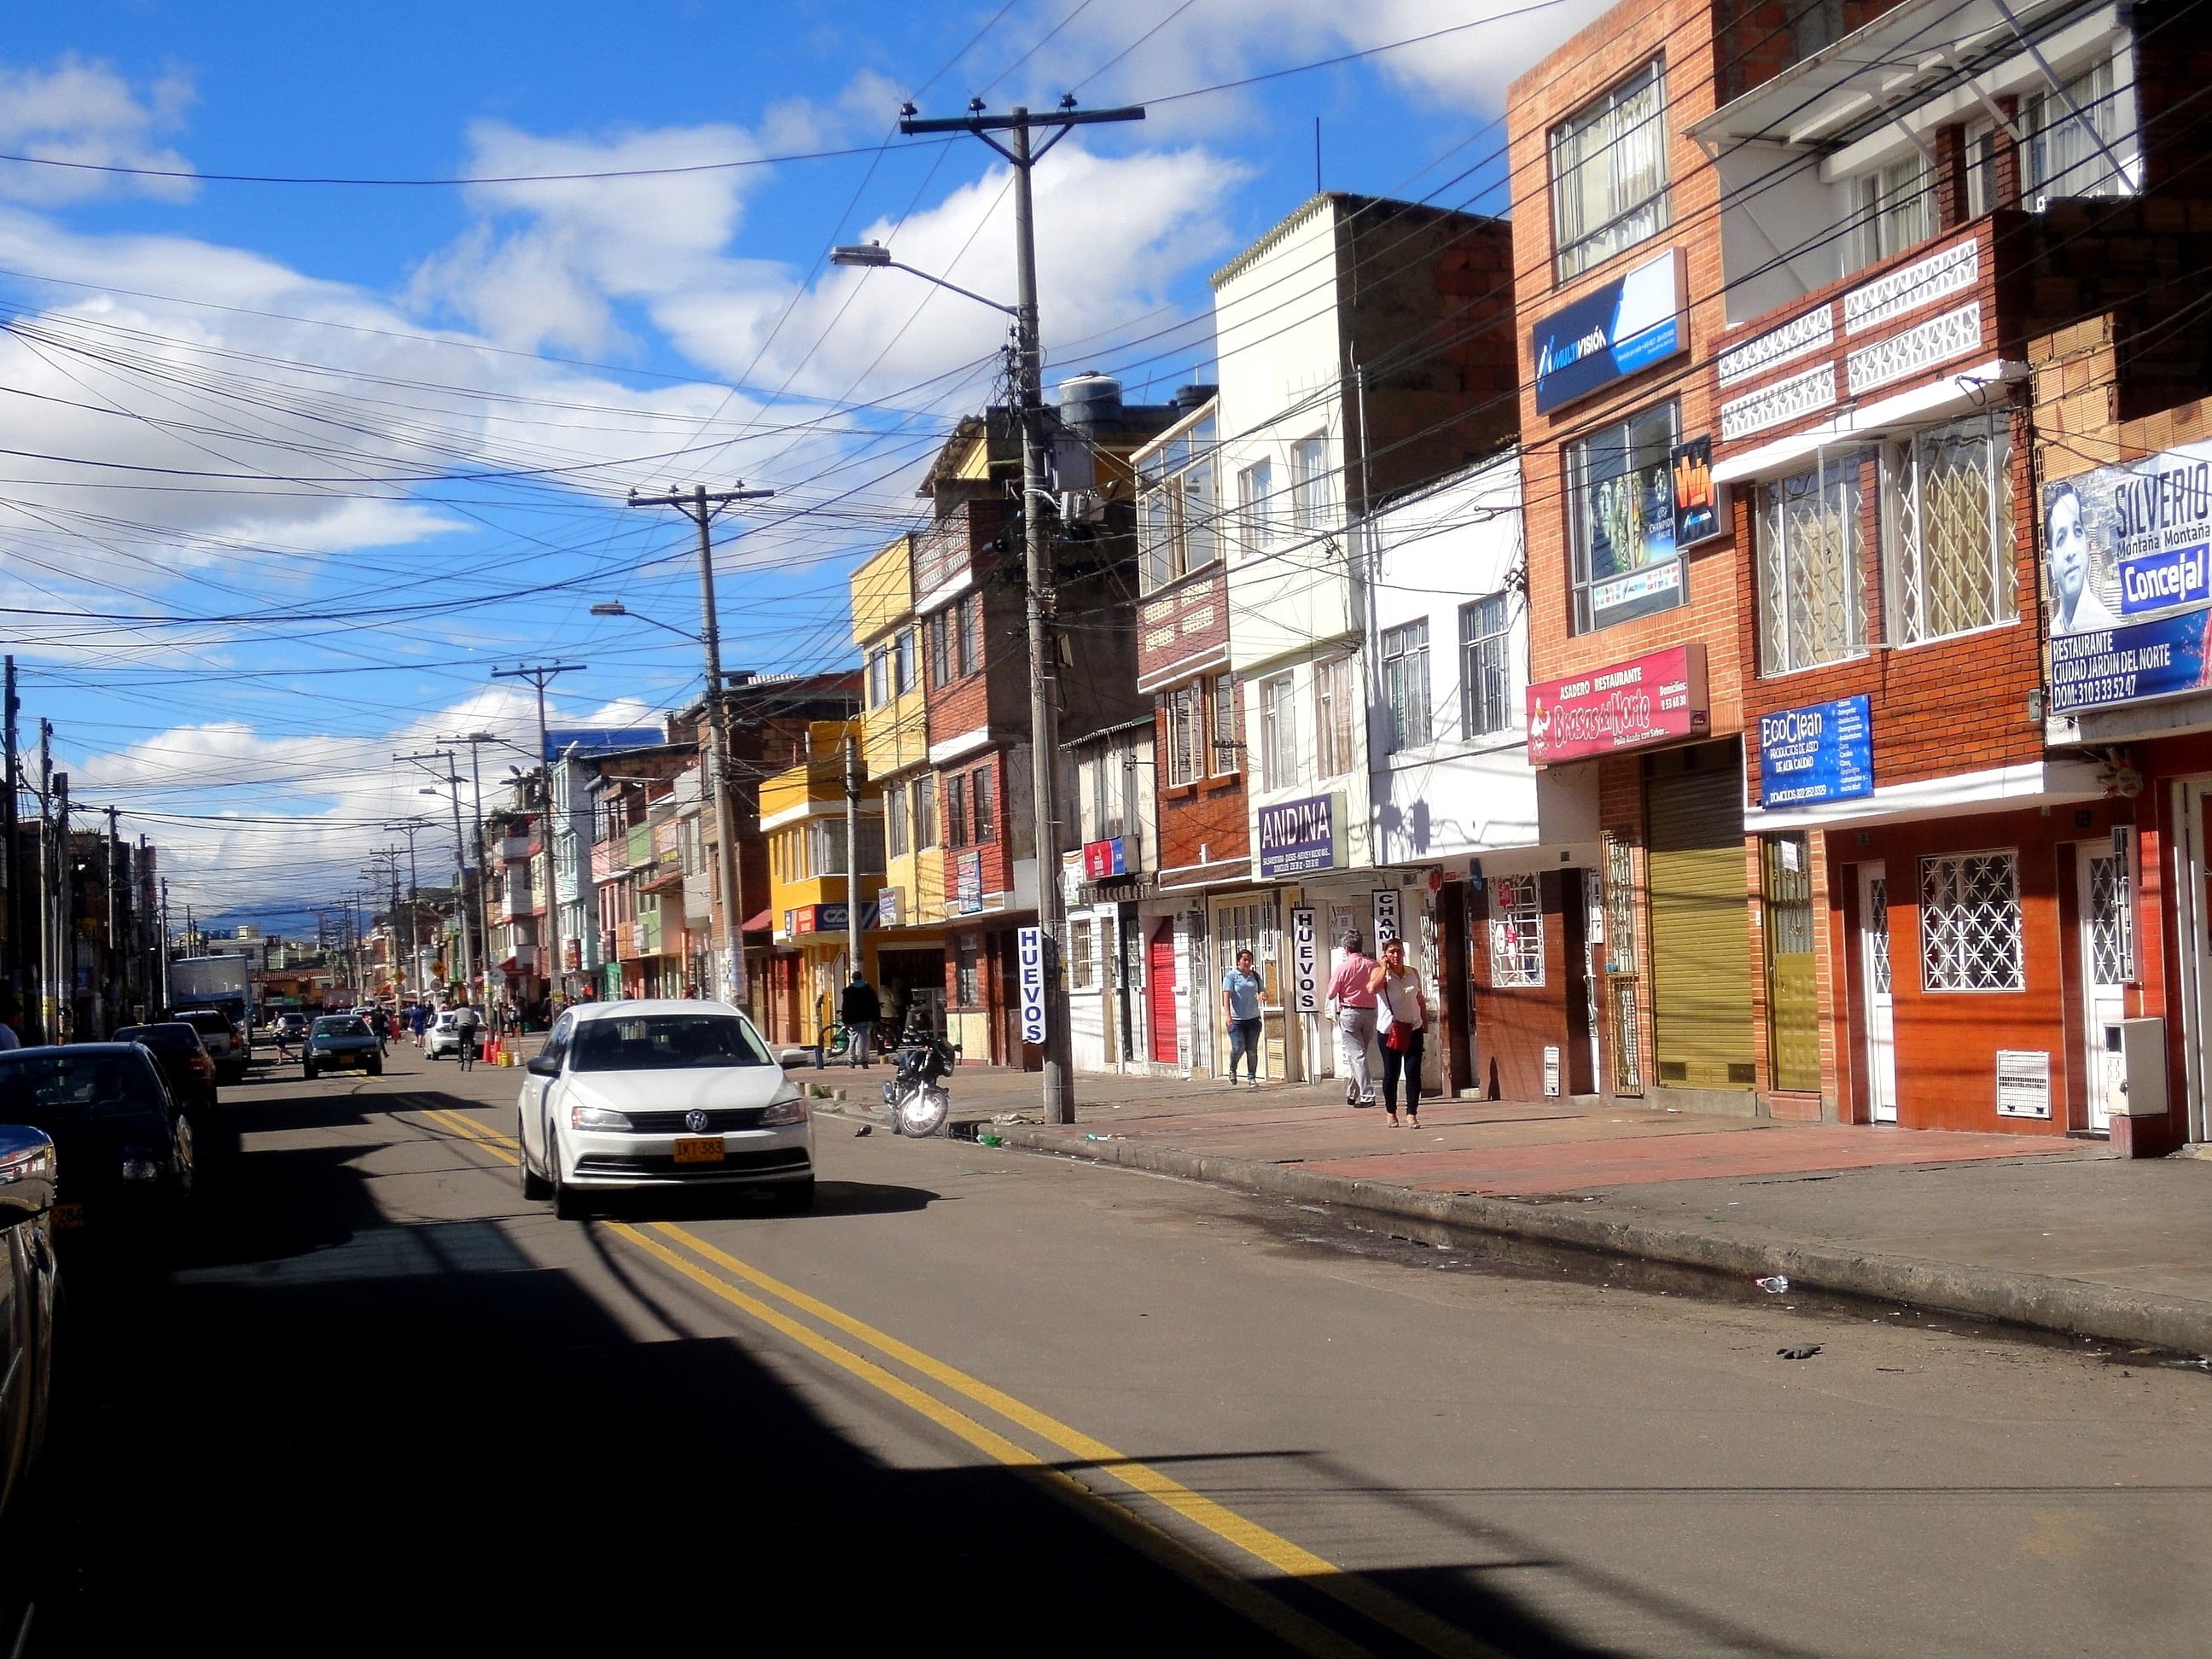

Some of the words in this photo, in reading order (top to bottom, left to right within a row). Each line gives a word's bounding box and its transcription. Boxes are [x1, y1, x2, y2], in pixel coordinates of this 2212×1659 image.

[2115, 462, 2209, 539] SILVERIO
[2116, 534, 2160, 558] Montaña
[2164, 522, 2210, 548] Montaña
[2124, 548, 2203, 602] Concejal
[2052, 631, 2114, 662] RESTAURANTE
[2053, 659, 2087, 685] CIUDAD
[2087, 652, 2120, 679] JARDIN
[2121, 649, 2139, 674] DEL
[2139, 643, 2171, 670] NORTE
[1560, 679, 1591, 701] ASADERO
[1594, 666, 1643, 693] RESTAURANTE
[2094, 680, 2100, 701] 3
[2101, 678, 2112, 701] 33
[2113, 676, 2125, 699] 52
[2125, 673, 2137, 696] 47
[1553, 705, 1600, 748] Brasas
[1610, 688, 1651, 736] Norte
[1761, 712, 1823, 748] EcoClean
[1261, 801, 1331, 850] ANDINA
[1298, 913, 1316, 1008] HUEVOS
[1021, 930, 1042, 1041] HUEVOS
